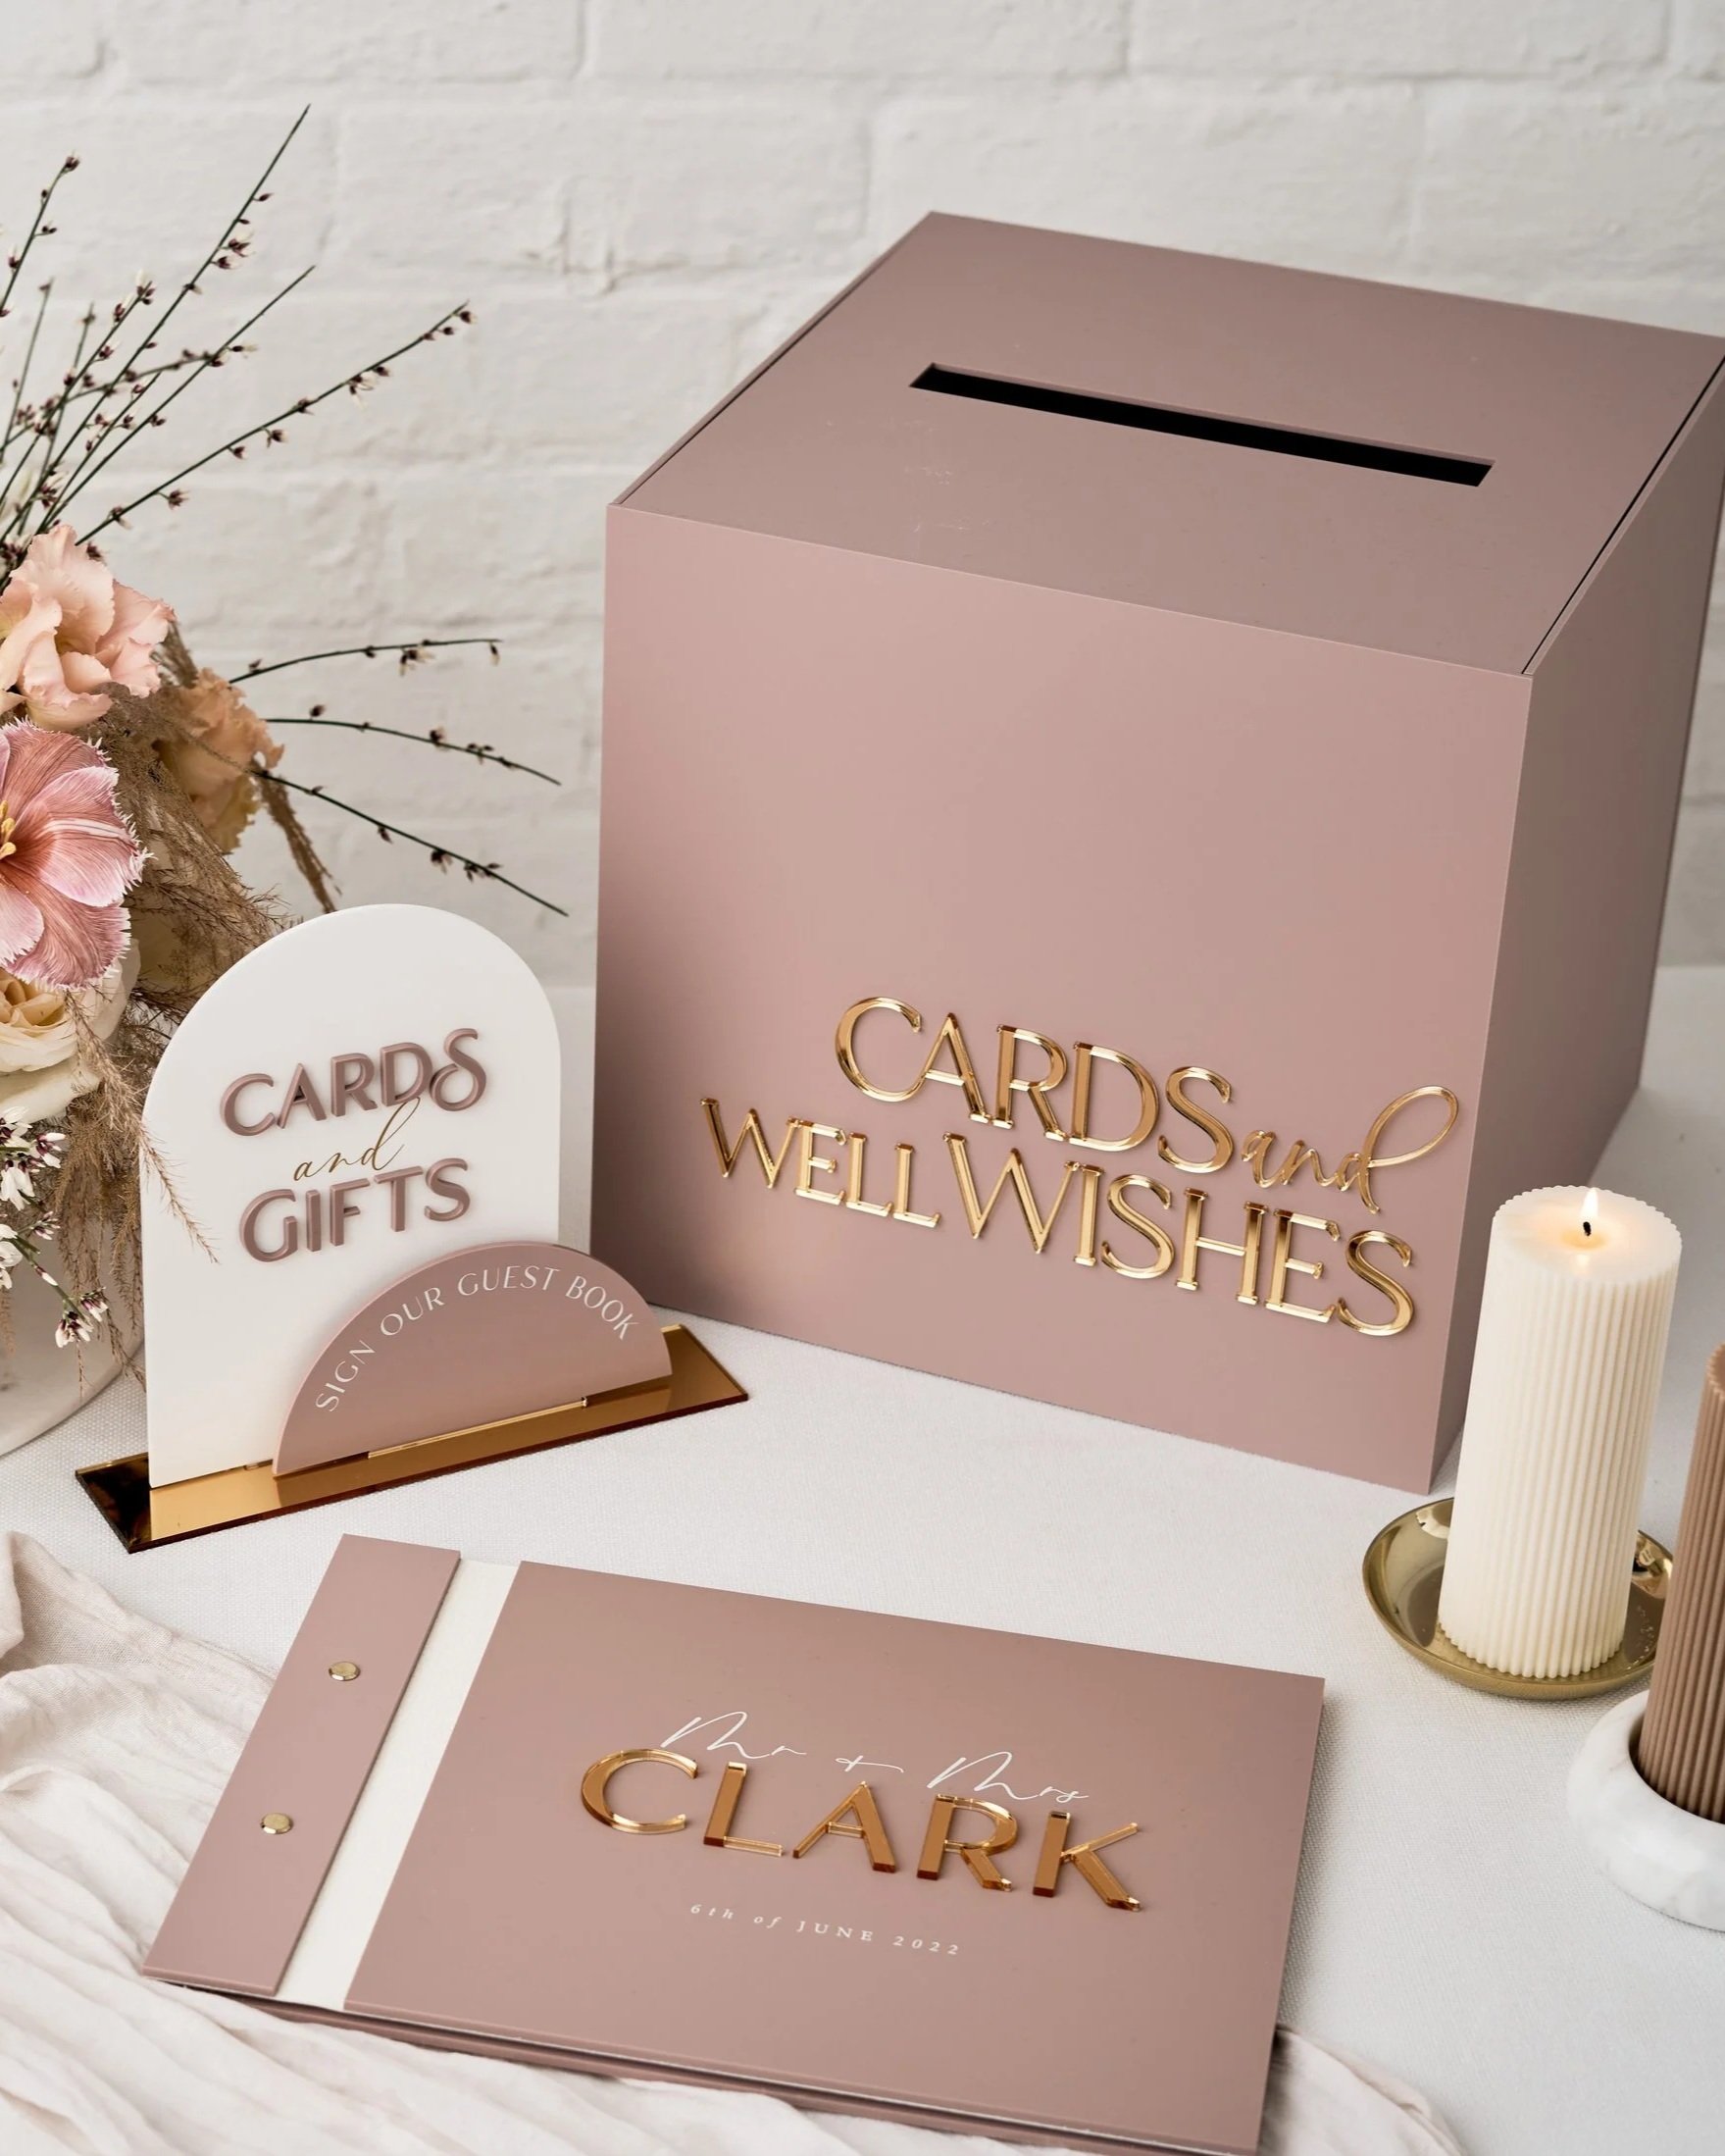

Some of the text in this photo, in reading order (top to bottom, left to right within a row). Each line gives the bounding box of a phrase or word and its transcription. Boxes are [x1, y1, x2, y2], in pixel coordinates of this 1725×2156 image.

[220, 1027, 488, 1137] CARDS
[834, 995, 1459, 1214] CARDS and
[293, 1096, 421, 1182] and
[239, 1157, 471, 1263] GIFTS
[699, 1097, 1415, 1337] WELL WISHES
[315, 1264, 640, 1412] SIGN OUR GUEST BOOK
[660, 1710, 807, 1759] Mr
[928, 1751, 1090, 1804] Mrs
[581, 1747, 1142, 1913] CLARK
[689, 1903, 961, 1956] 6th of JUNE 2022
